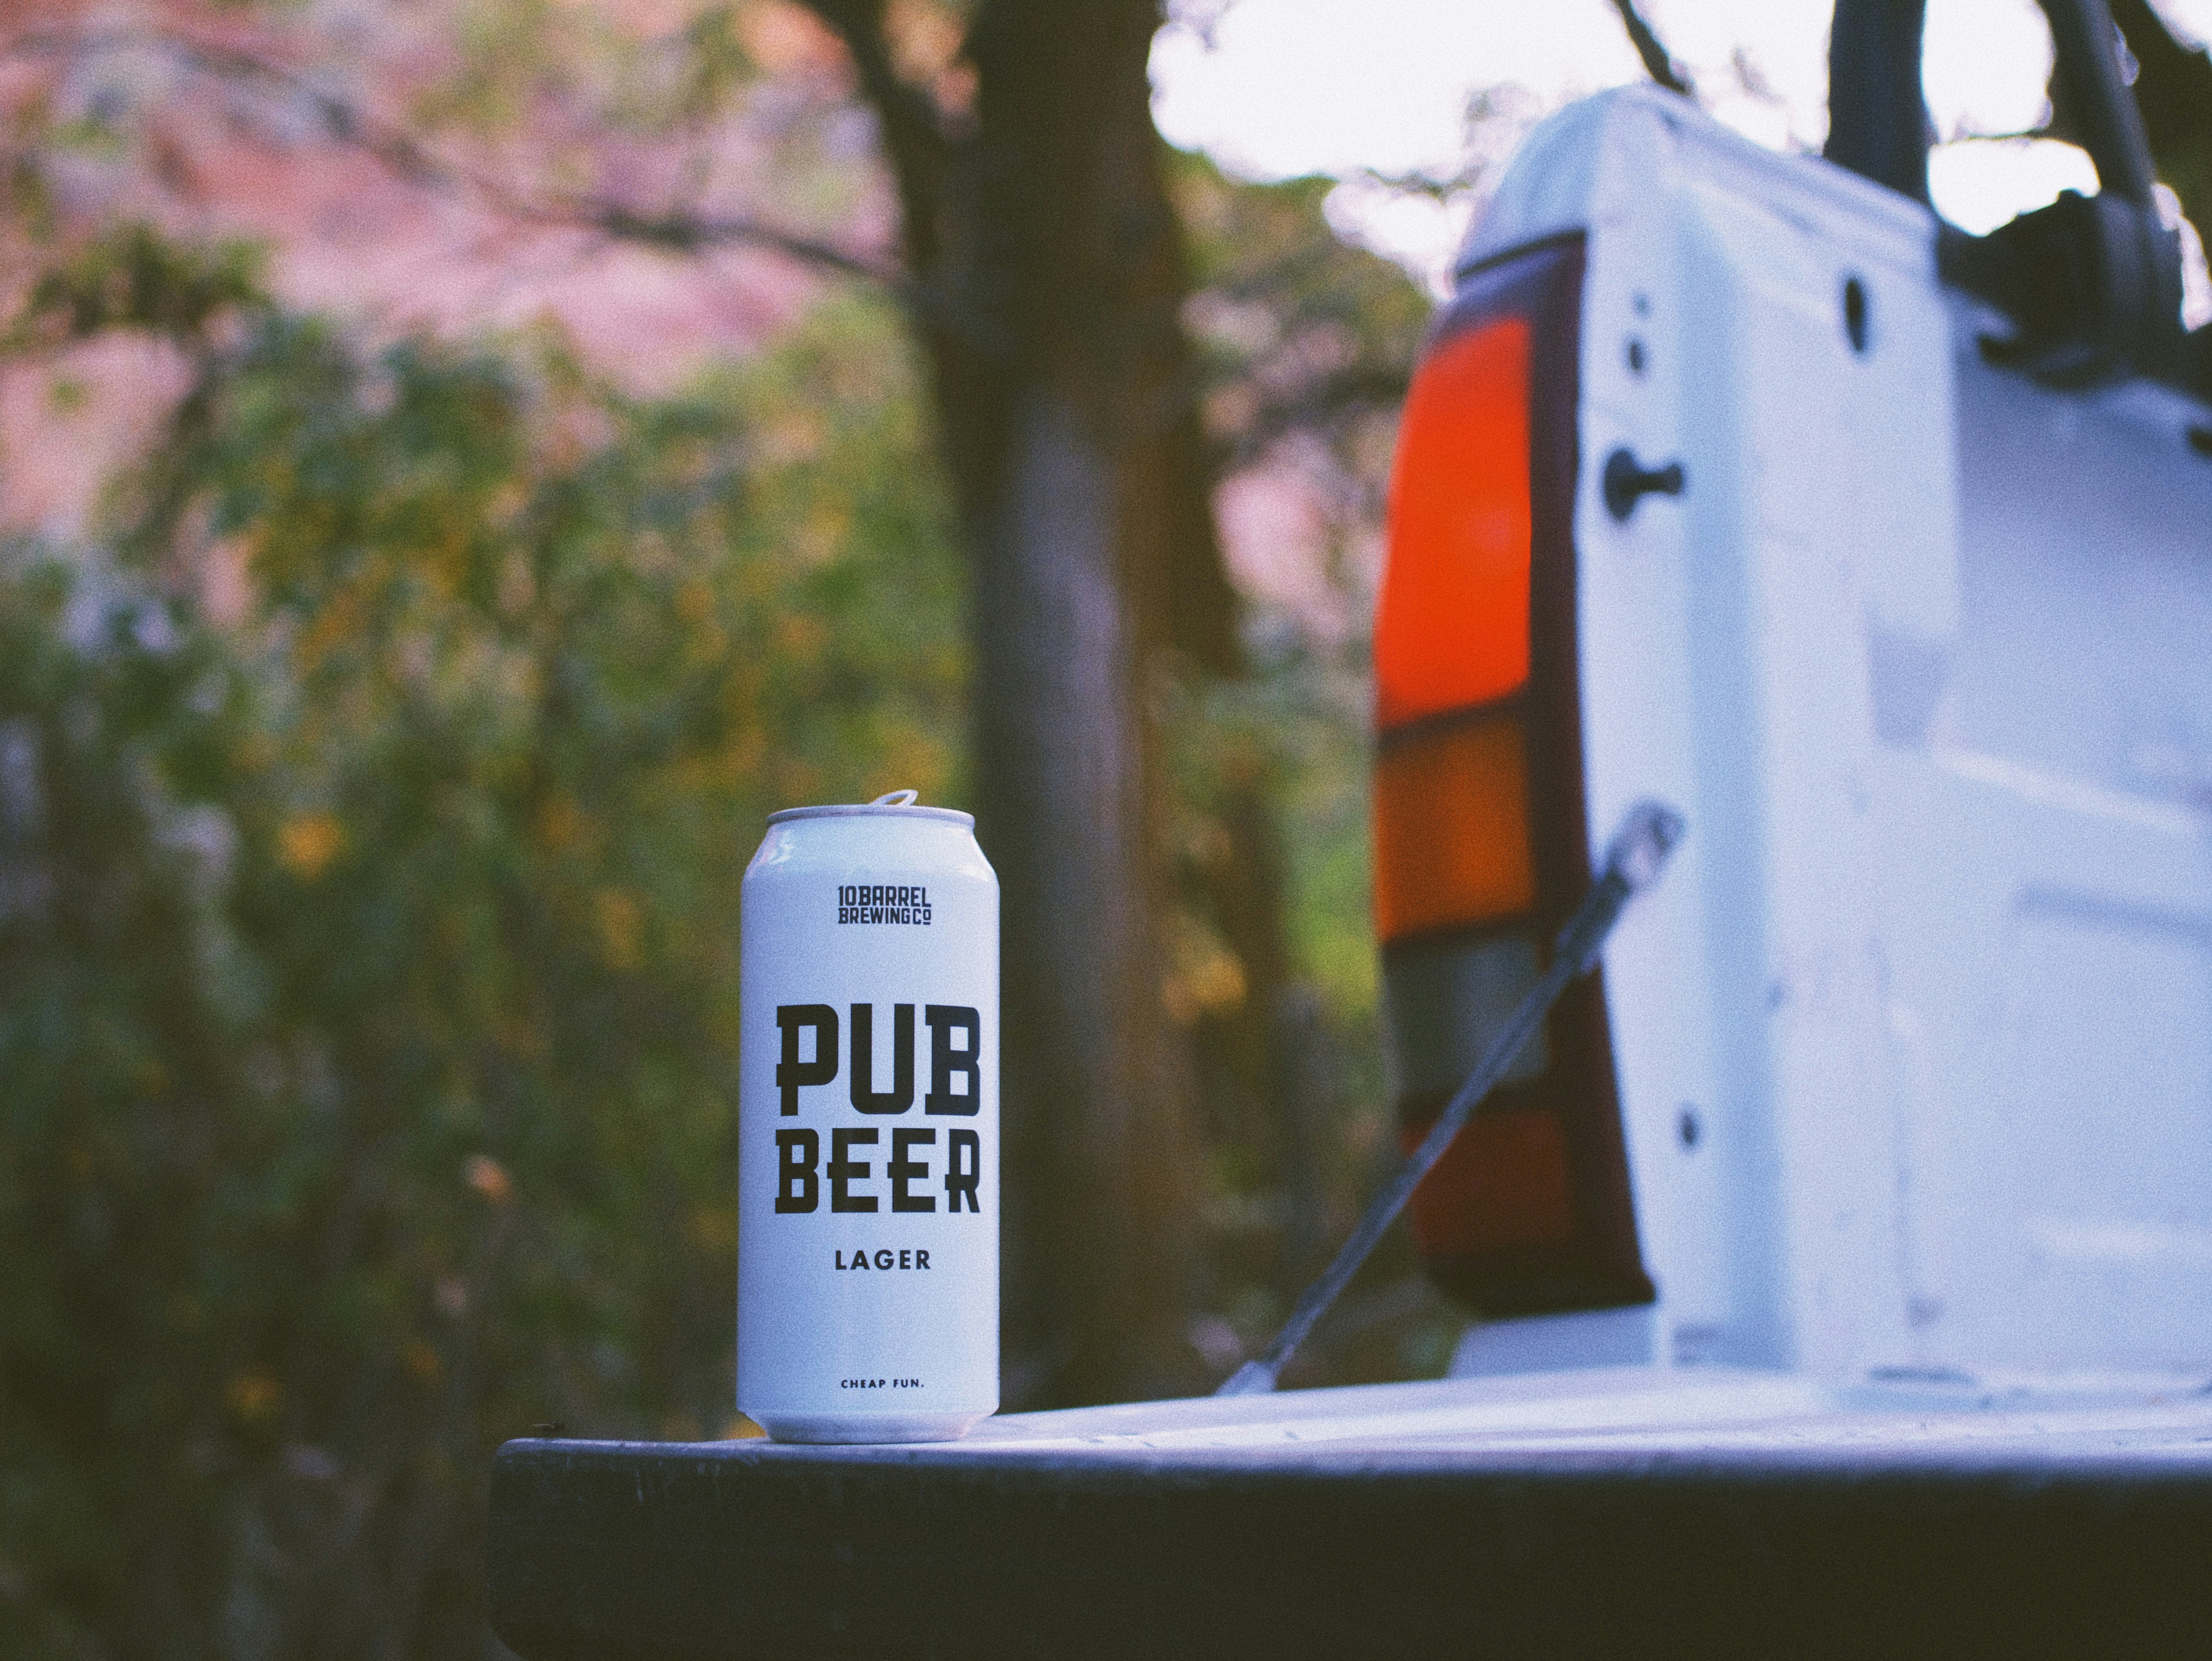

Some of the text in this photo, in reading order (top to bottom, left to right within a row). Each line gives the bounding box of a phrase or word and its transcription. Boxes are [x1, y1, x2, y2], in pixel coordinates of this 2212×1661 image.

[838, 907, 910, 924] BREWING
[776, 1003, 980, 1117] PUB
[775, 1127, 980, 1214] BEER
[835, 1249, 931, 1270] LAGER
[841, 1379, 924, 1388] CHEAP FUN.
